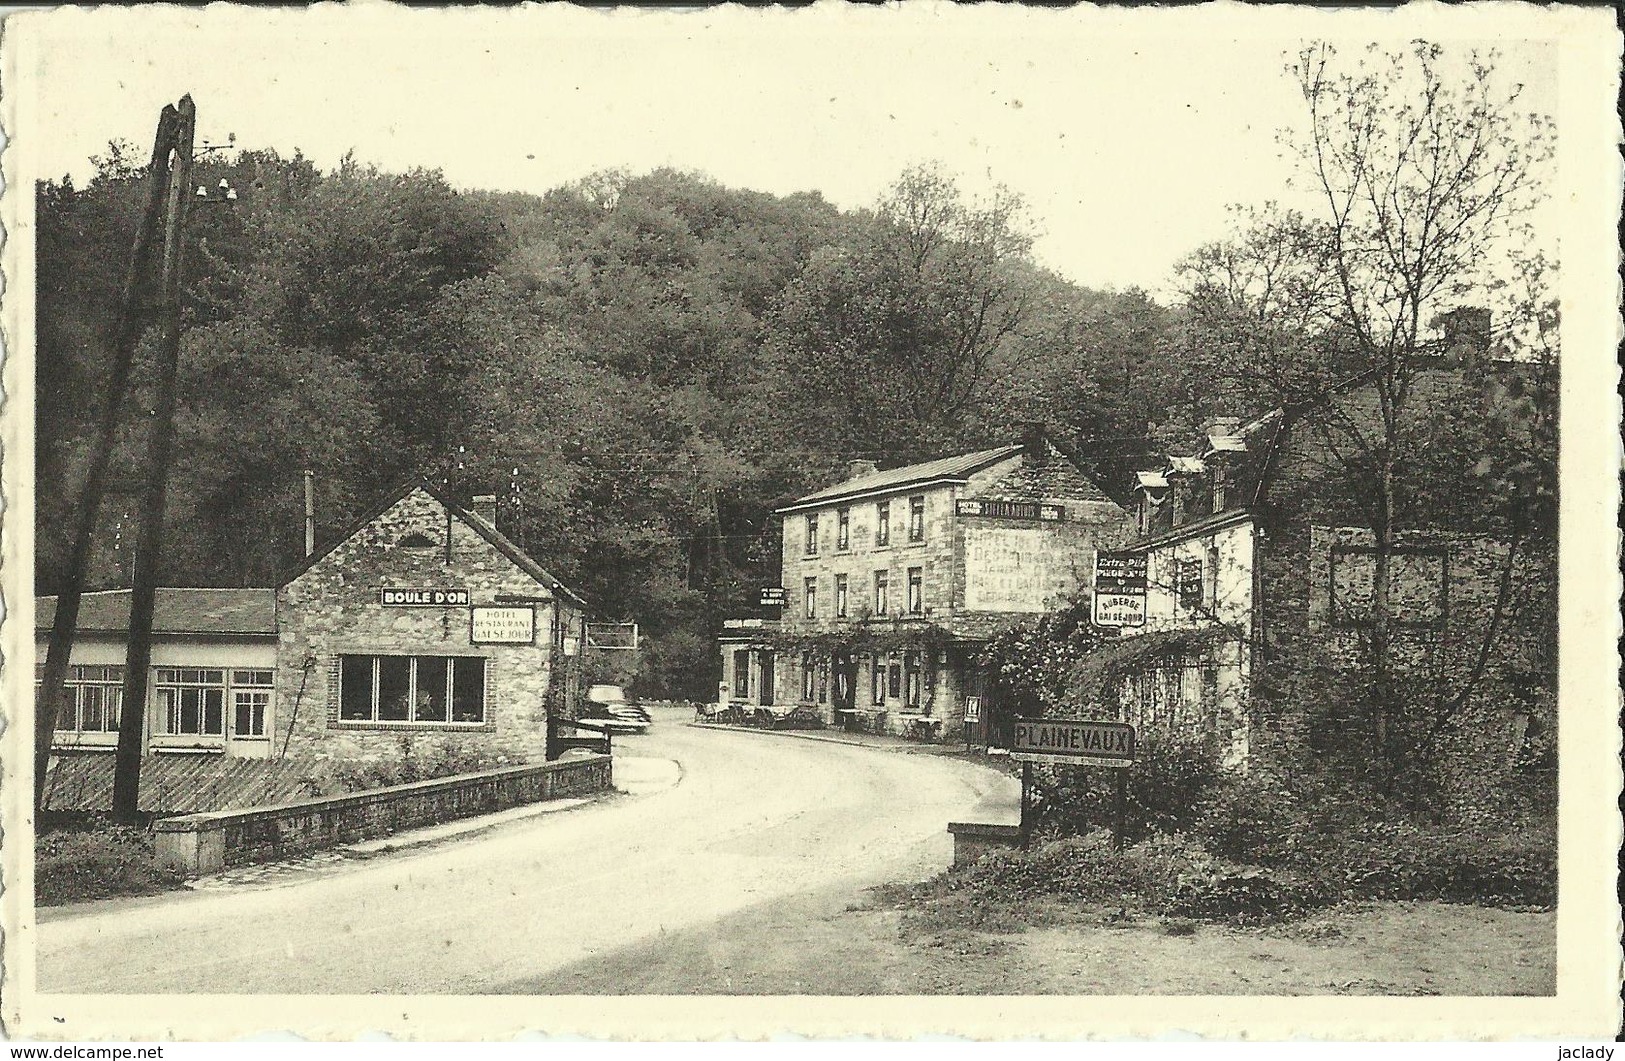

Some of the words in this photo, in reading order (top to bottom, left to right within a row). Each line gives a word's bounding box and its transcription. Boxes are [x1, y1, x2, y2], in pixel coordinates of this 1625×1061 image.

[384, 592, 431, 604] BOULE
[435, 592, 467, 604] D'OR
[1102, 597, 1141, 611] AUBERGE
[1098, 612, 1111, 621] GAI
[474, 620, 530, 628] RESTAURANT
[474, 630, 491, 639] GAI
[1015, 726, 1128, 752] PLAINEVAUX
